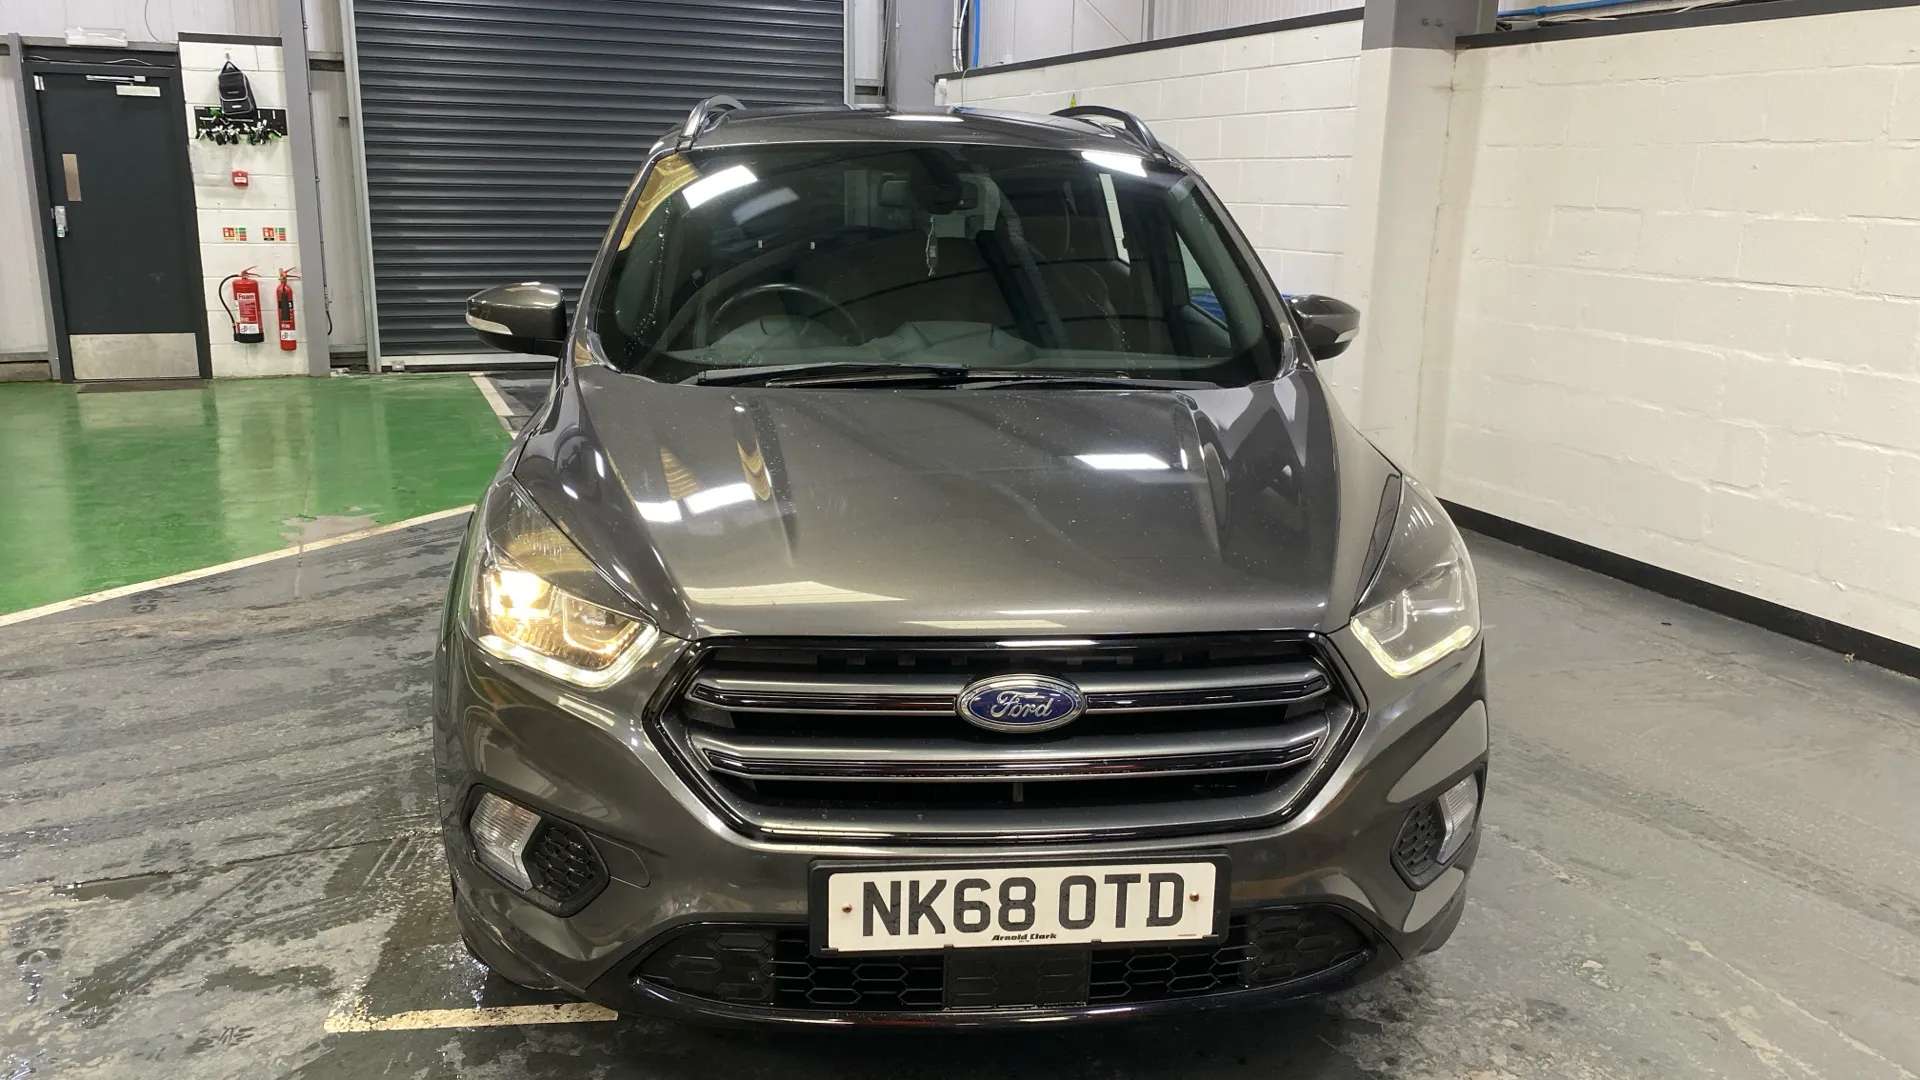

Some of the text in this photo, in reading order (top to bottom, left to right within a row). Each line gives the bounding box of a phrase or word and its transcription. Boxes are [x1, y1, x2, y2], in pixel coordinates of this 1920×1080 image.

[990, 691, 1054, 717] Ford
[862, 872, 1184, 937] NK68 OTD
[1029, 932, 1057, 940] Clark
